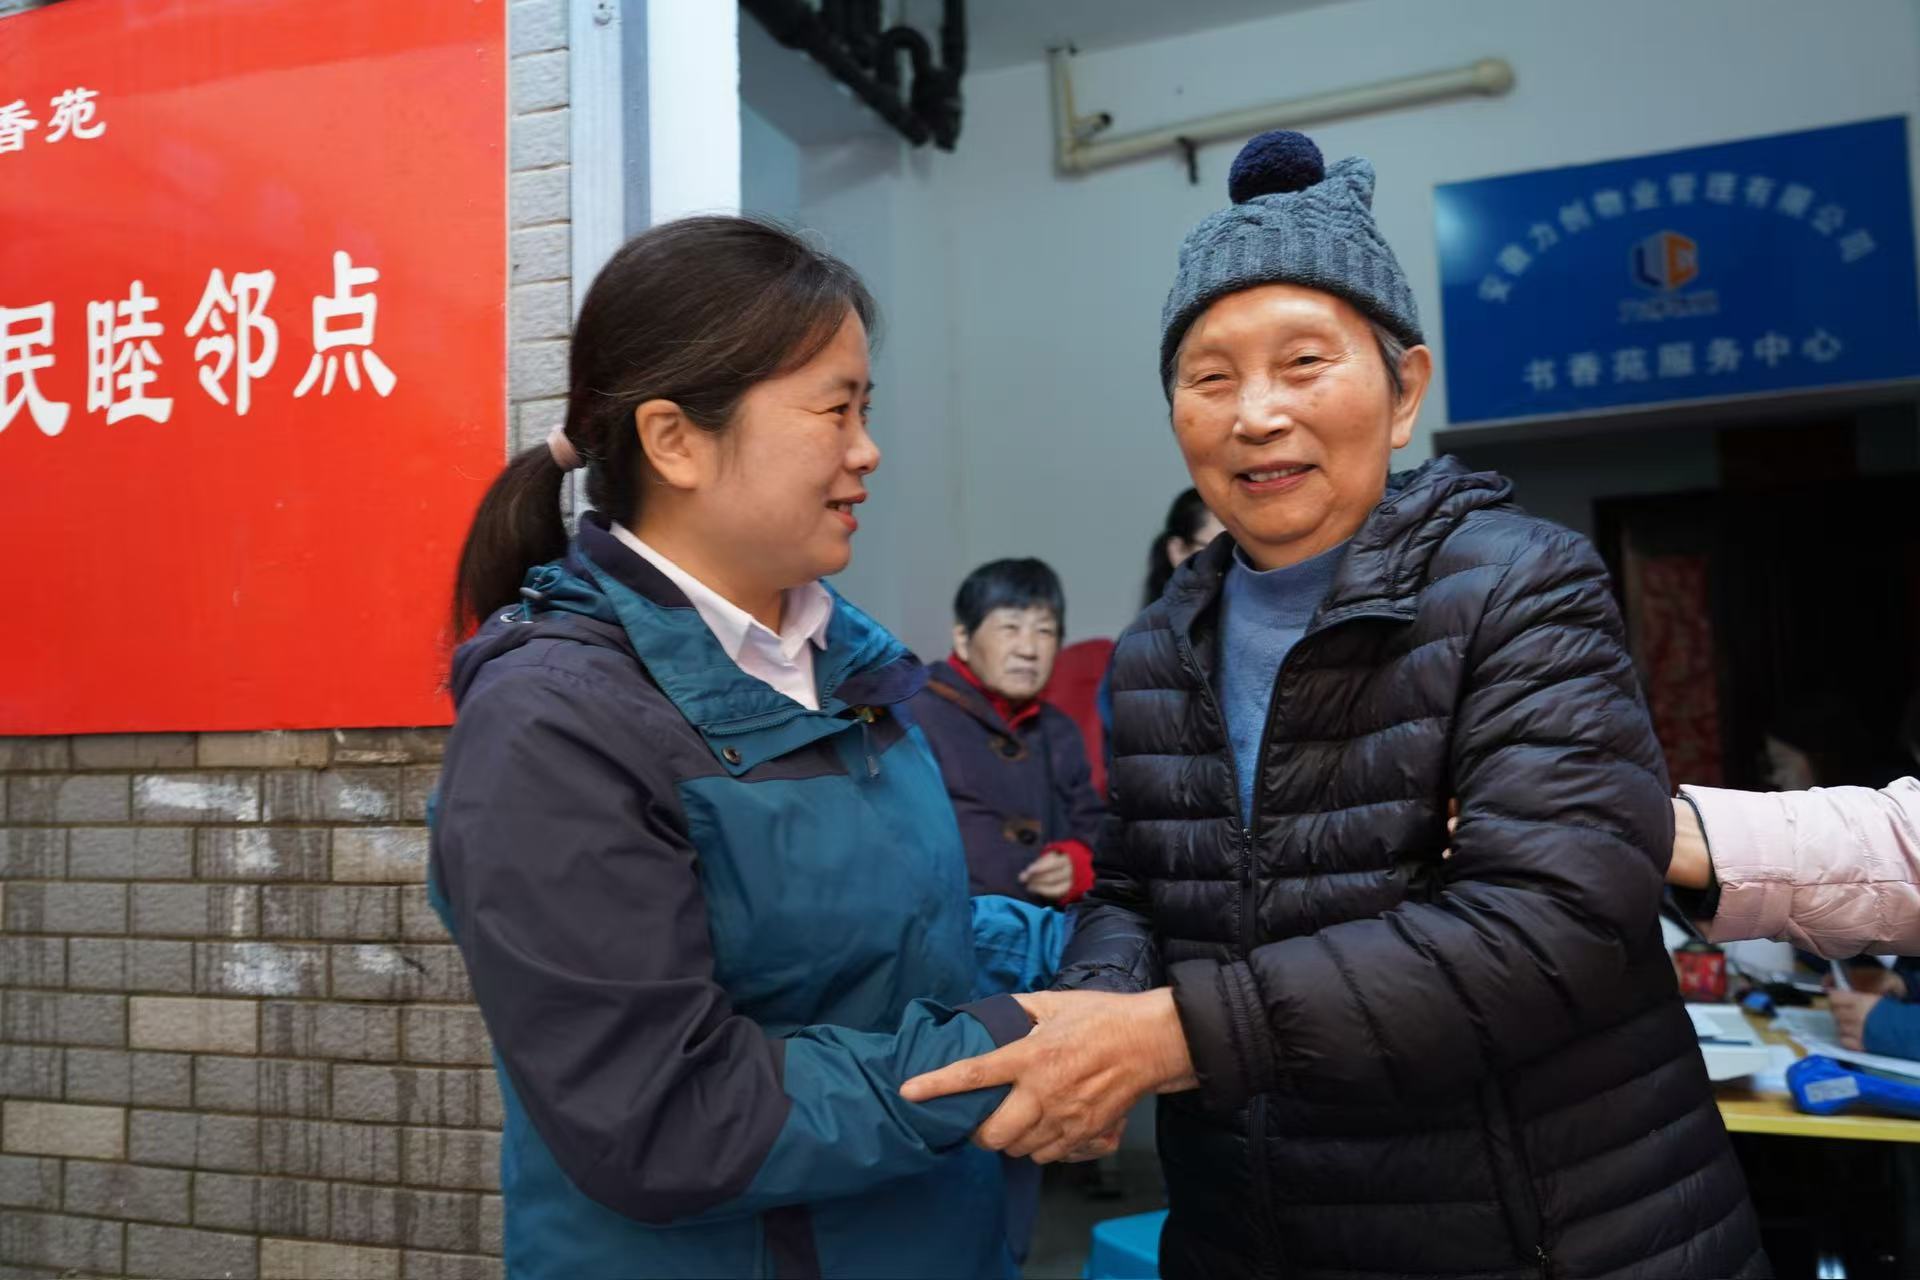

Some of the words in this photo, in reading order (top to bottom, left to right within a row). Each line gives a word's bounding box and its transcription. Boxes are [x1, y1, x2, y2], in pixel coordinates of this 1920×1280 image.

[0, 250, 397, 436] 民睦邻点
[1524, 328, 1841, 391] 书香苑服务中心
